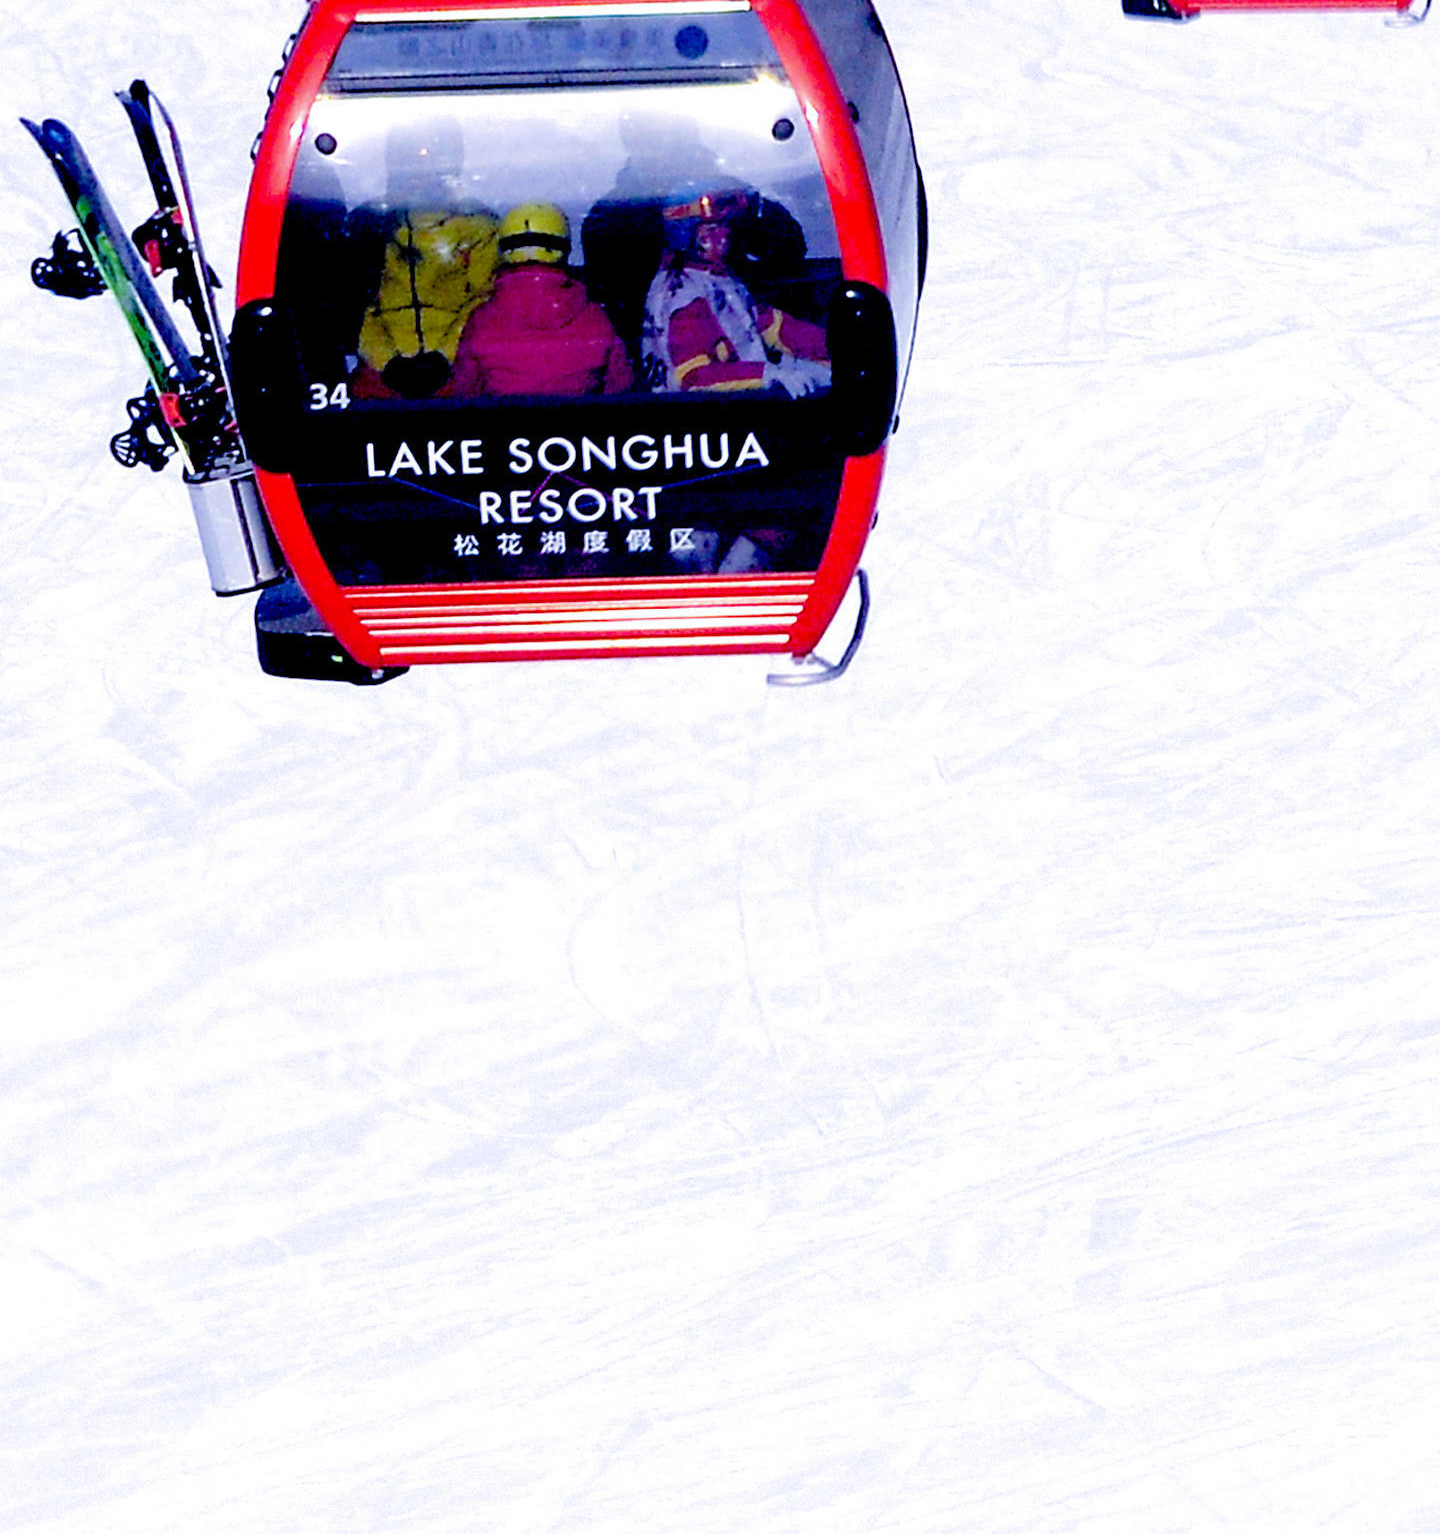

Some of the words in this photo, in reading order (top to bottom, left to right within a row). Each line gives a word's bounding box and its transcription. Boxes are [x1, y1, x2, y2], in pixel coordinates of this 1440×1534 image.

[309, 382, 351, 410] 34
[366, 439, 484, 478] LAKE
[508, 432, 770, 473] SONGHUA
[479, 486, 663, 525] RESORT
[453, 528, 696, 557] 松花湖度假区
